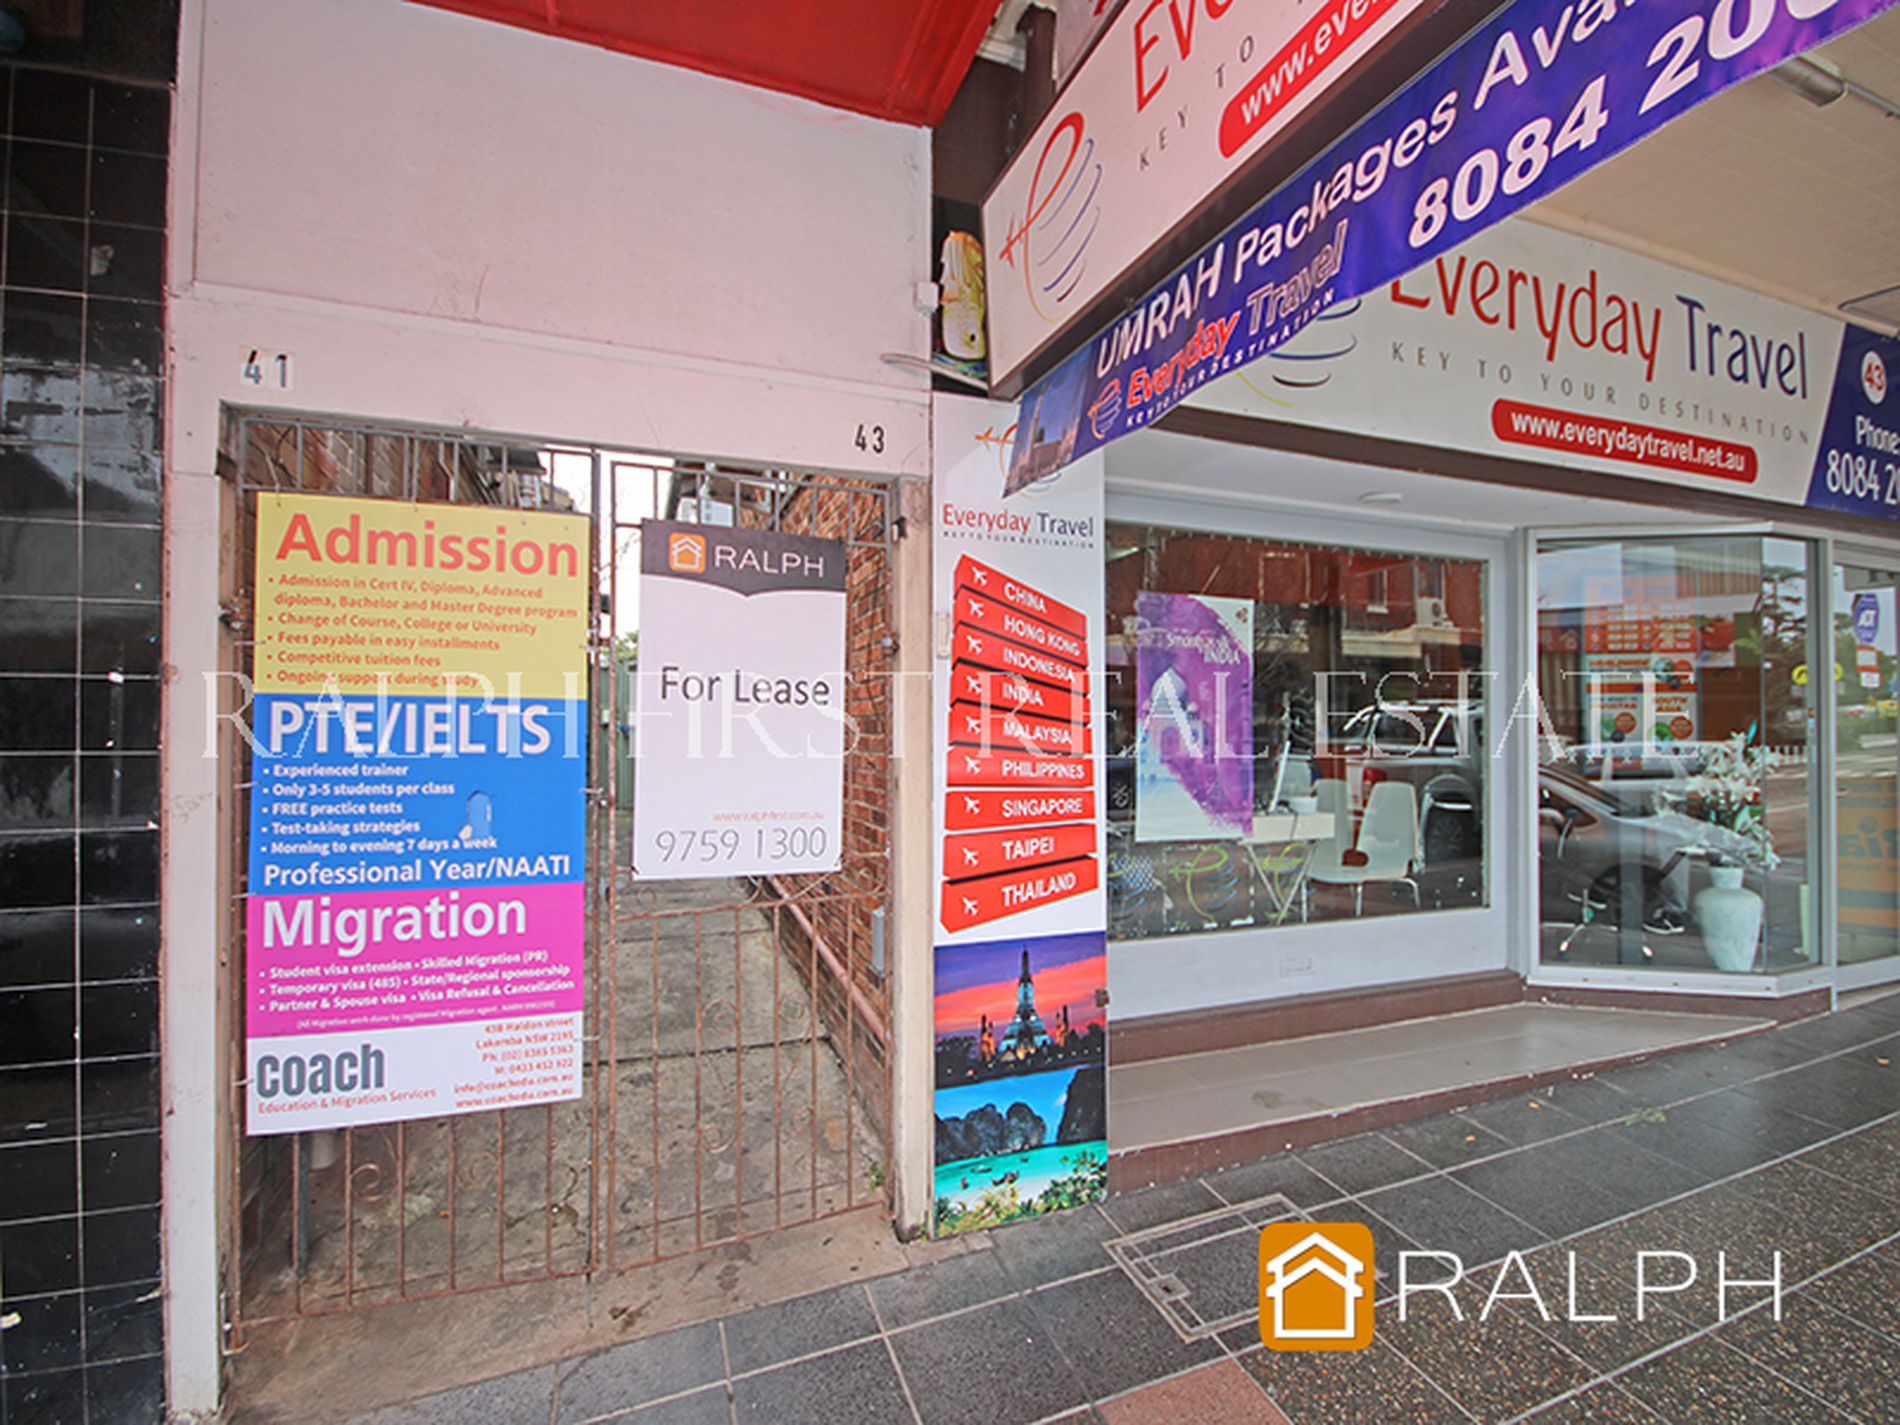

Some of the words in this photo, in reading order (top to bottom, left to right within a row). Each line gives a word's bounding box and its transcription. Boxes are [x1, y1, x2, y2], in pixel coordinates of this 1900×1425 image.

[1134, 0, 1233, 113] Ev
[1241, 0, 1380, 124] www.eve
[1140, 106, 1187, 171] KEY
[1215, 36, 1255, 88] TO
[1408, 75, 1609, 248] 8084
[1638, 0, 1840, 115] 20
[1098, 243, 1224, 378] UMRAH
[1235, 90, 1458, 283] Packages
[1473, 0, 1634, 110] Ava
[1127, 311, 1239, 409] Everyday
[1247, 219, 1348, 334] Travel
[1210, 288, 1335, 376] DESTINATION
[1676, 294, 1807, 400] Travel
[243, 349, 287, 386] 41
[1865, 362, 1885, 391] 43
[1392, 341, 1451, 371] KEY
[1479, 358, 1512, 384] TO
[1540, 373, 1616, 404] YOUR
[1640, 391, 1809, 445] DESTINATION
[855, 425, 886, 453] 43
[1511, 408, 1745, 473] www.everydaytravel.net.au
[1826, 449, 1880, 501] 8084
[1885, 463, 1900, 505] 2
[943, 503, 1031, 536] Everyday
[1037, 511, 1094, 538] Travel
[275, 513, 577, 578] Admission
[714, 545, 824, 577] RALPH
[279, 575, 349, 588] Admission
[354, 578, 366, 588] in
[370, 578, 398, 590] Cert
[421, 581, 479, 597] Diploma,
[483, 585, 543, 598] Advanced
[1004, 582, 1048, 613] CHINA
[274, 592, 336, 608] diploma,
[339, 596, 399, 609] Bachelor
[403, 599, 427, 610] and
[431, 600, 474, 612] Master
[478, 602, 521, 616] Degree
[525, 606, 577, 619] program
[278, 612, 329, 628] Change
[333, 614, 347, 625] of
[351, 614, 401, 629] Course,
[404, 617, 451, 632] College
[456, 621, 468, 630] or
[472, 620, 536, 636] University
[1003, 615, 1047, 643] HONG
[1049, 634, 1081, 656] KONG
[278, 632, 308, 644] Fees
[313, 634, 366, 647] payable
[370, 635, 382, 645] in
[385, 637, 415, 649] easy
[419, 636, 500, 650] installments
[277, 651, 360, 665] Competitive
[365, 653, 410, 665] tuition
[414, 654, 440, 666] fees
[1003, 648, 1075, 682] INDONESIA
[339, 673, 391, 685] suppot
[395, 673, 438, 687] during
[661, 665, 721, 702] For
[734, 669, 829, 706] Lease
[1003, 682, 1043, 706] INDIA
[270, 701, 552, 755] PTE/IELTS
[1003, 721, 1073, 744] MALAYSIA
[273, 764, 359, 778] Experienced
[361, 764, 409, 776] trainer
[1002, 760, 1085, 779] PHILIPPINES
[272, 784, 305, 798] Only
[309, 783, 330, 795] 3-5
[334, 783, 393, 795] students
[396, 785, 418, 797] per
[421, 782, 454, 794] class
[272, 803, 308, 815] FREE
[311, 802, 365, 816] practice
[369, 802, 402, 813] tests
[1002, 798, 1083, 818] SINGAPORE
[272, 822, 349, 836] Test-taking
[353, 820, 420, 835] strategies
[271, 841, 329, 855] Morning
[332, 841, 347, 852] to
[350, 839, 404, 854] evening
[407, 838, 415, 850] 7
[418, 838, 448, 853] days
[452, 840, 459, 849] a
[463, 836, 497, 849] week
[656, 829, 740, 864] 9759
[756, 826, 827, 861] 1300
[1002, 837, 1054, 860] TAIPEI
[264, 859, 421, 886] Professional
[429, 855, 570, 880] Year/NAATI
[1002, 872, 1076, 907] THAILAND
[263, 891, 526, 957] Migration
[270, 966, 321, 979] Student
[324, 964, 348, 975] visa
[352, 960, 411, 974] extension
[421, 955, 462, 968] Skilled
[466, 952, 520, 968] Migration
[523, 950, 548, 964] (PR)
[270, 982, 337, 996] Temporary
[342, 979, 366, 990] visa
[411, 970, 498, 986] State/Regional
[419, 989, 443, 1001] Visa
[447, 985, 489, 998] Refusal
[492, 984, 500, 995] &
[503, 980, 574, 995] Cancellation
[270, 998, 317, 1012] Partner
[320, 999, 330, 1009] &
[334, 996, 378, 1010] Spouse
[382, 994, 406, 1004] visa
[476, 1036, 522, 1049] Lakemba
[525, 1033, 547, 1043] NSW
[256, 1043, 385, 1099] coach
[258, 1094, 318, 1114] Education
[320, 1096, 329, 1108] &
[331, 1091, 387, 1111] Migration
[388, 1087, 437, 1104] Services
